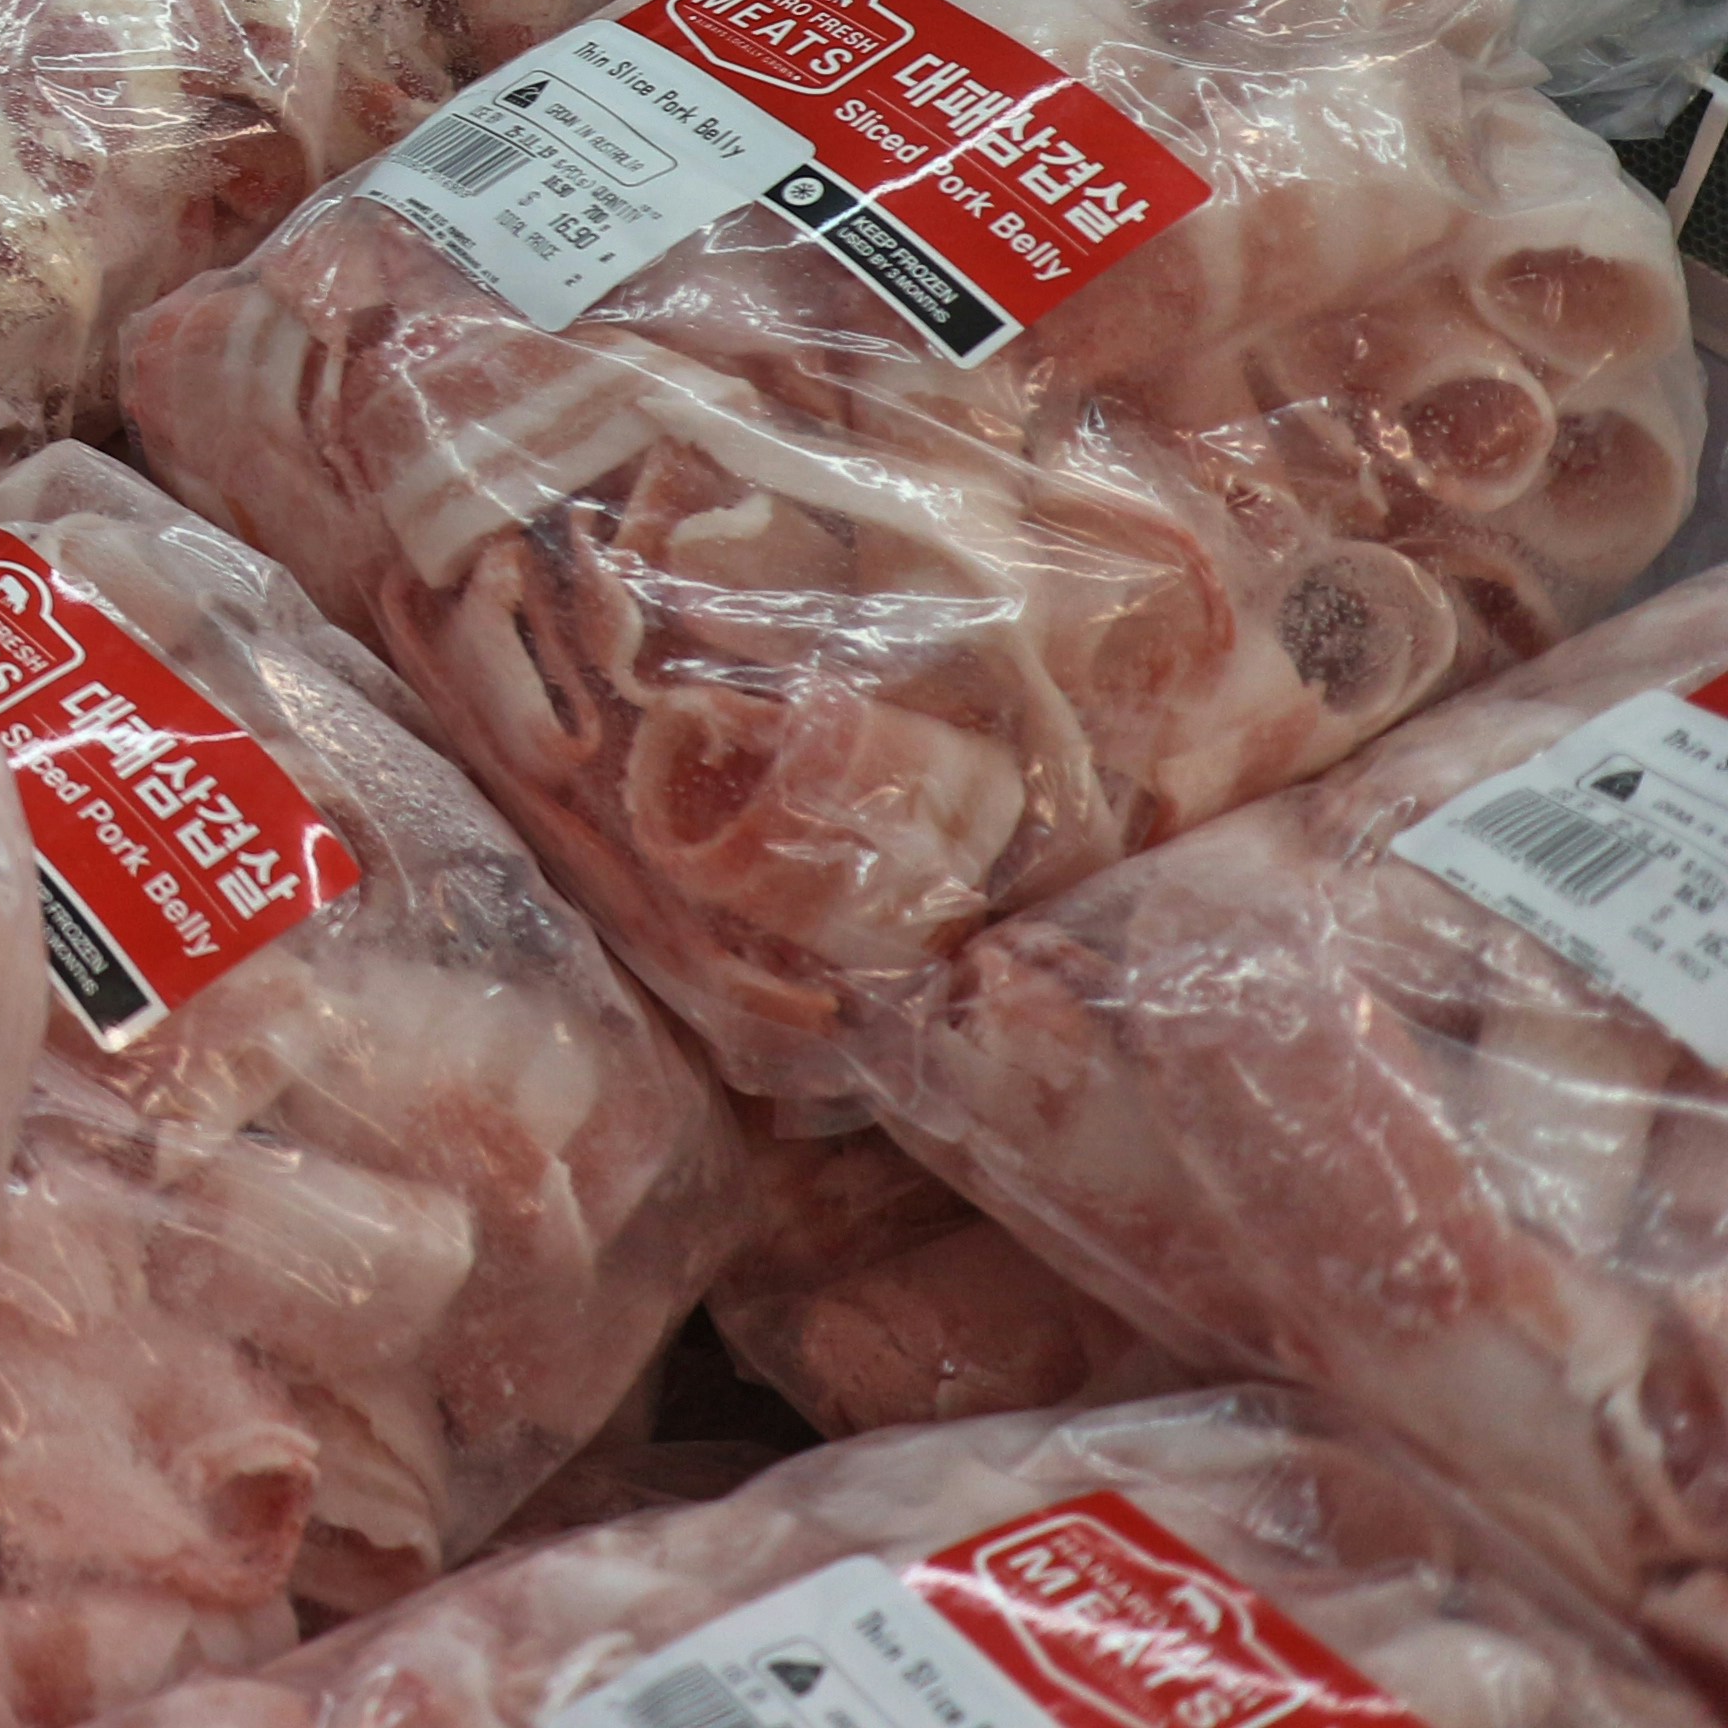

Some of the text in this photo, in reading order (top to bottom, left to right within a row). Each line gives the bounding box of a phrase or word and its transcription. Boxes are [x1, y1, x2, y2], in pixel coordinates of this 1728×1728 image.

[808, 12, 880, 54] FRESH
[572, 40, 746, 160] Thin Slice Pork Belly
[893, 53, 1151, 244] 대패삼겹살
[547, 212, 601, 250] 16.90
[834, 98, 929, 164] Sliced
[988, 211, 1072, 282] Belly
[837, 225, 951, 324] USED BY 3 MONTHS
[848, 215, 959, 305] KEEP FROZEN
[59, 680, 302, 921] 대패삼겹살
[77, 798, 221, 959] Pork Belly
[45, 899, 110, 977] FROZEN
